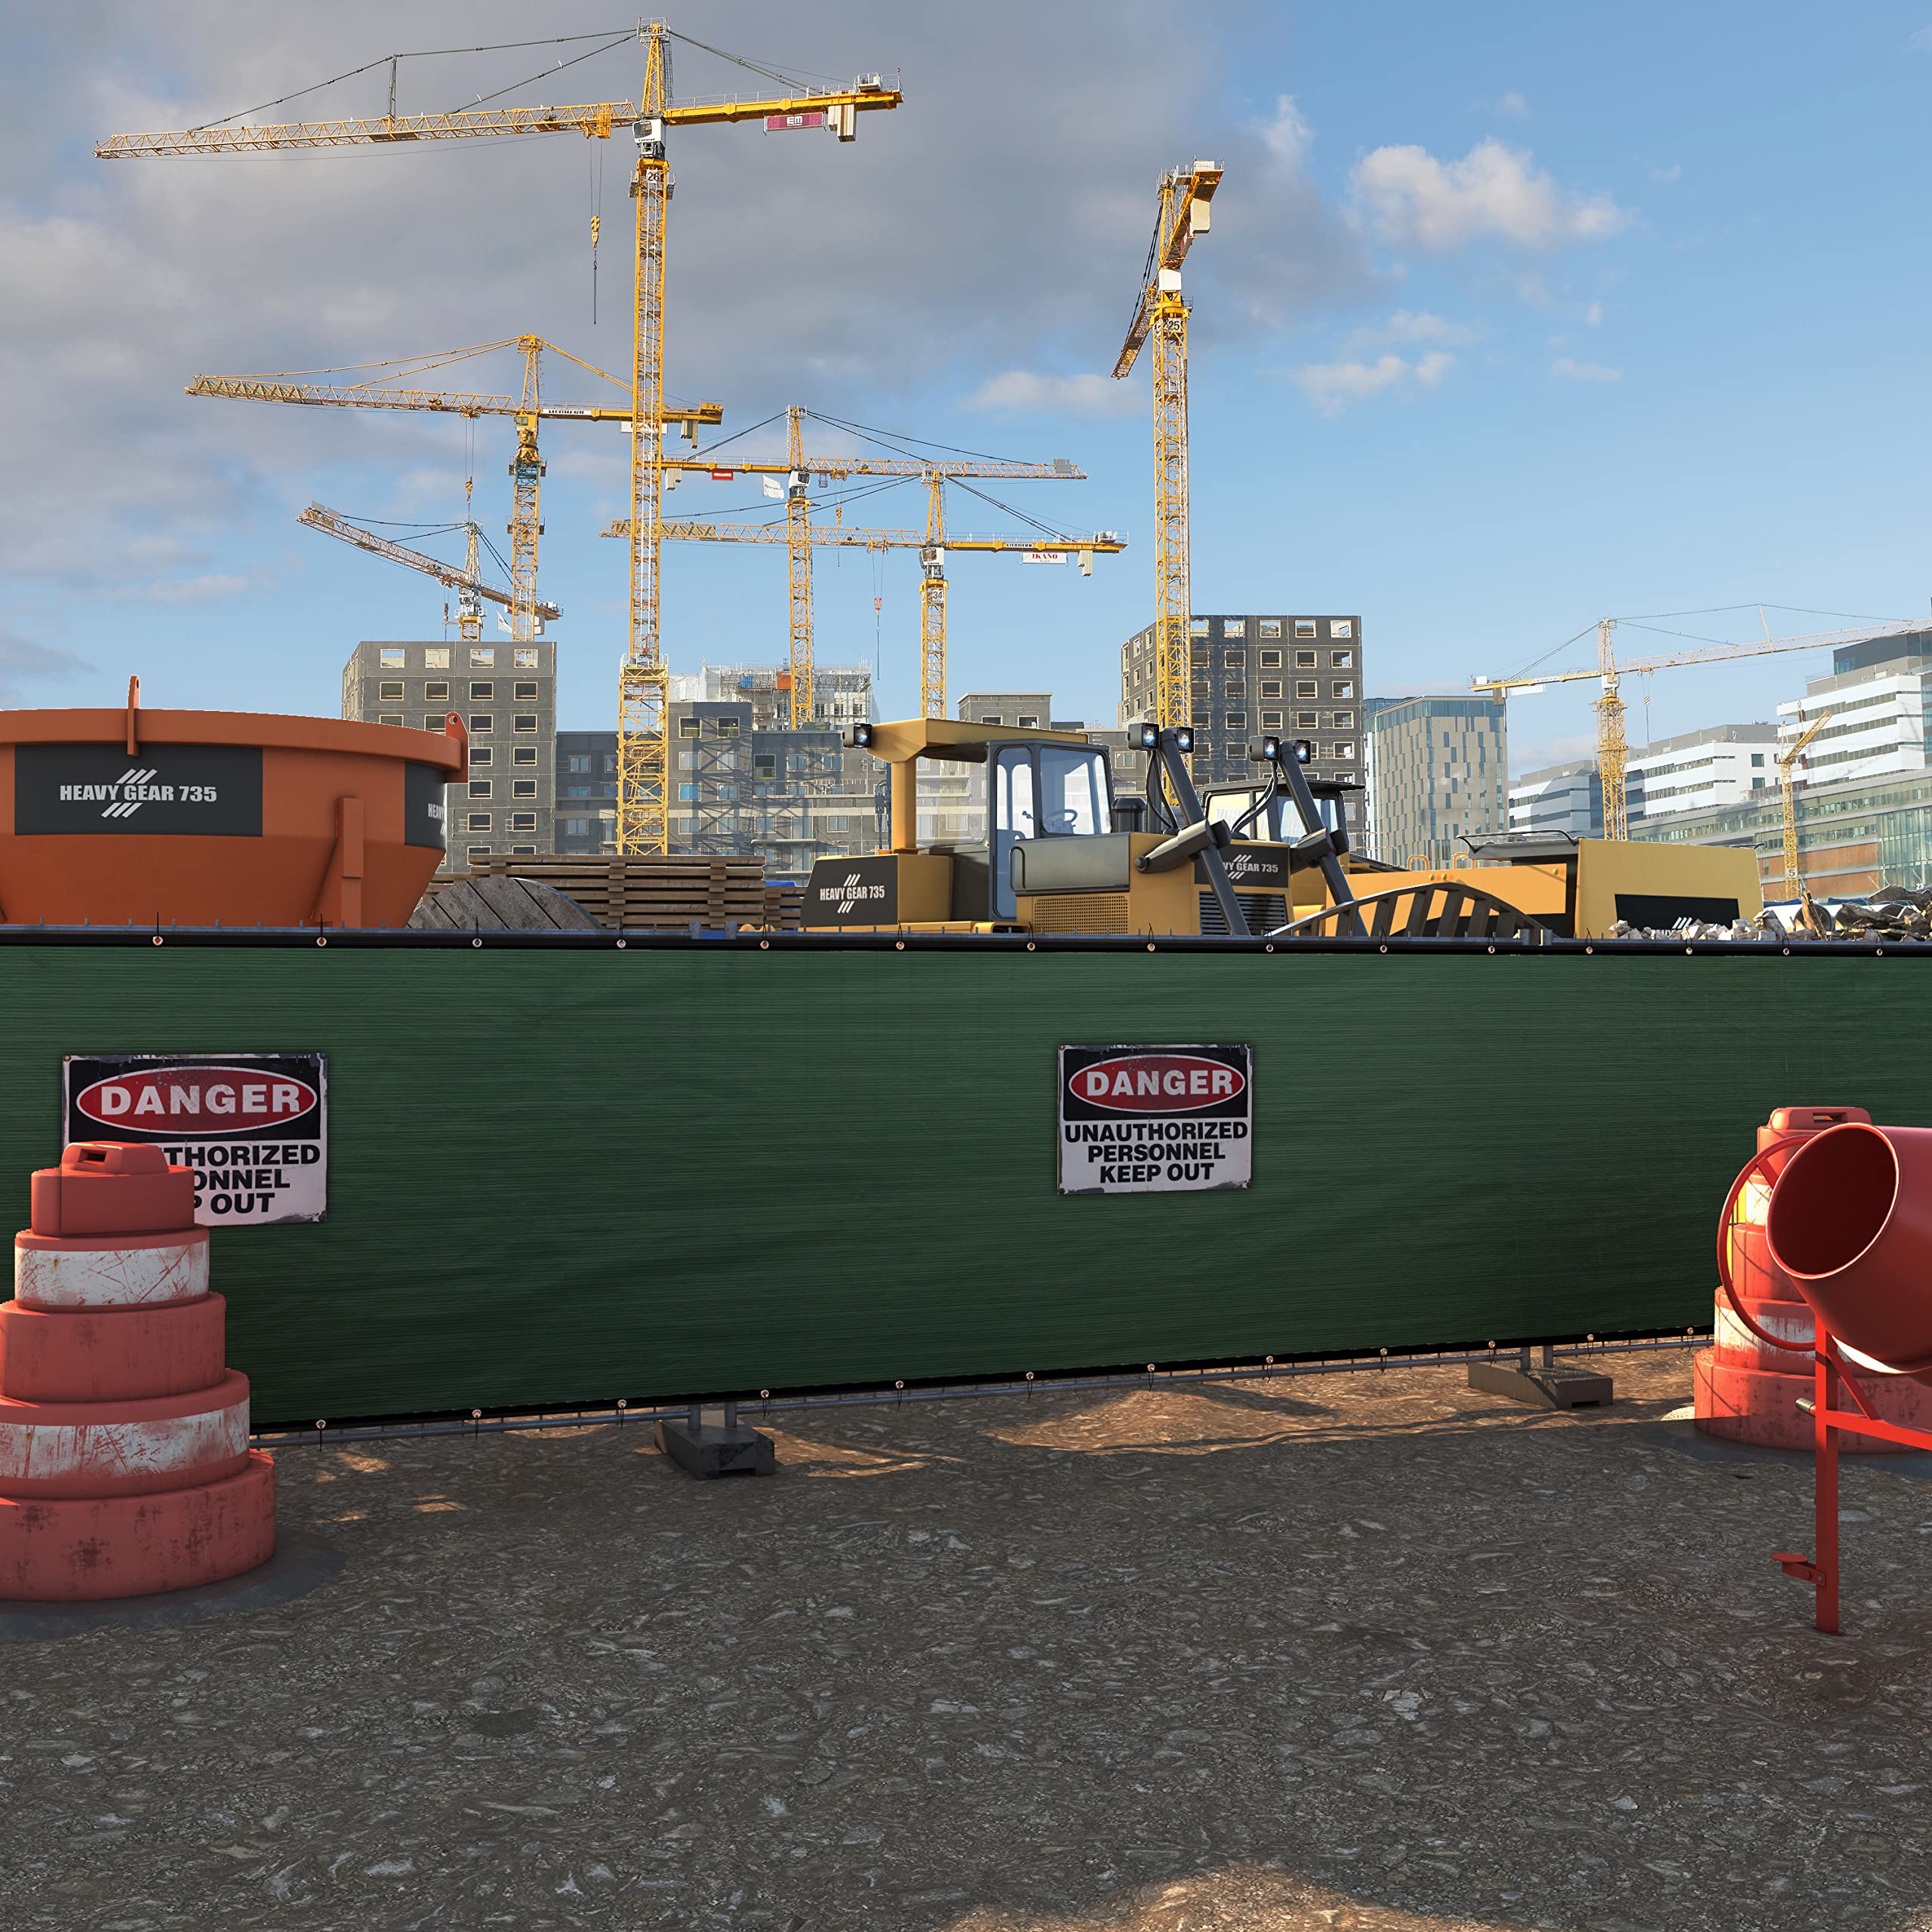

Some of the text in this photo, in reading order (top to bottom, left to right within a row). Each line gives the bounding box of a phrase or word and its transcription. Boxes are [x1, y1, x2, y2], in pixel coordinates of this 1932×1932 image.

[787, 116, 802, 125] EM
[648, 172, 660, 181] 26
[1169, 321, 1180, 330] 25
[933, 591, 943, 599] 34
[60, 785, 217, 802] HEAVY GEAR 735
[1236, 863, 1260, 872] GEAR
[1261, 863, 1278, 872] 735
[820, 885, 885, 900] HEAVY GEAR 735
[1086, 1070, 1232, 1096] DANGER
[100, 1084, 300, 1115] DANGER
[1065, 1121, 1247, 1143] UNAUTHORIZED
[163, 1145, 320, 1167] THORIZED
[1088, 1143, 1226, 1163] PERSONNEL
[194, 1169, 291, 1191] ONNEL
[1100, 1163, 1214, 1184] KEEP OUT
[211, 1192, 275, 1214] OUT
